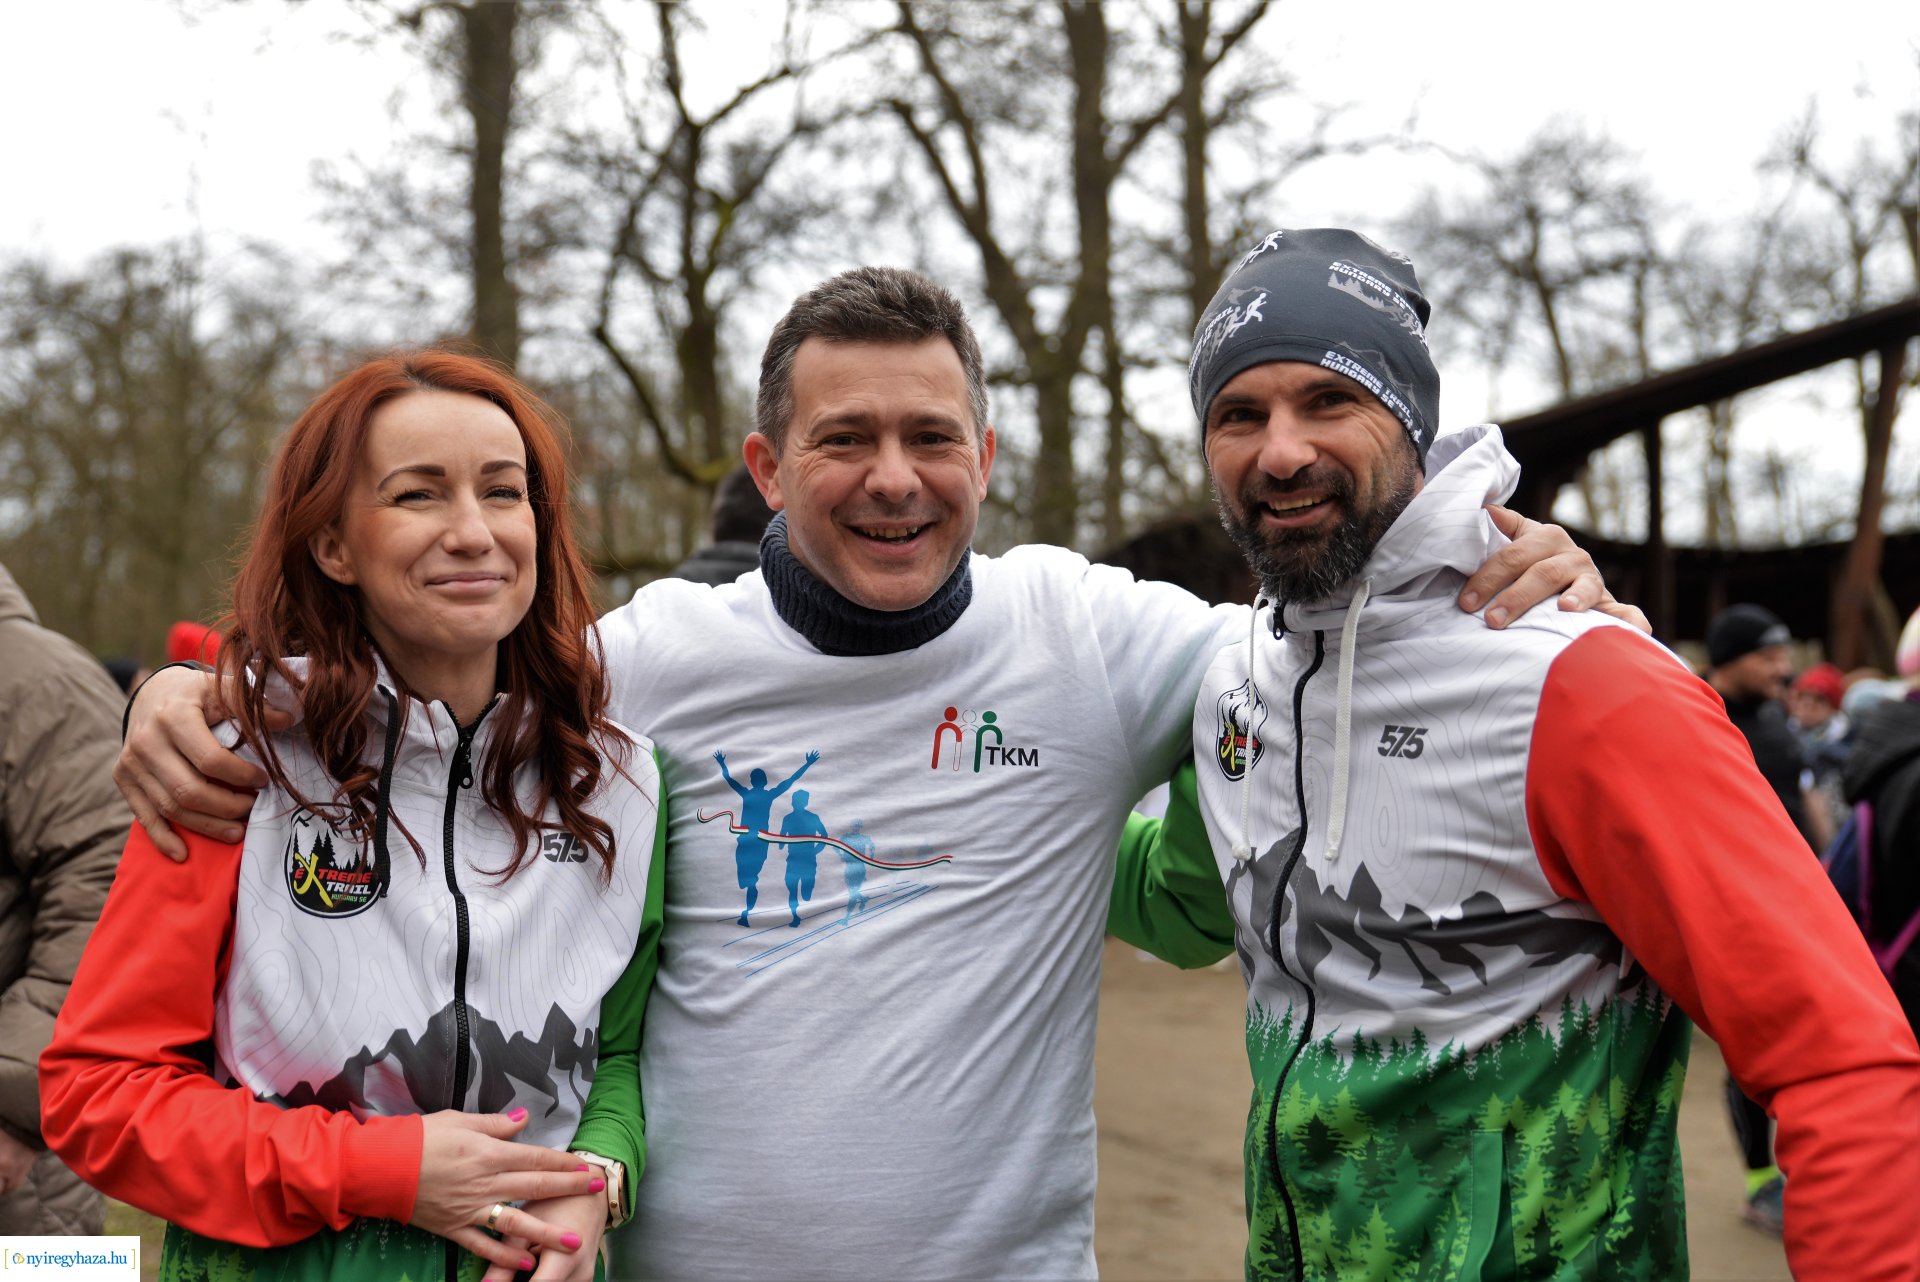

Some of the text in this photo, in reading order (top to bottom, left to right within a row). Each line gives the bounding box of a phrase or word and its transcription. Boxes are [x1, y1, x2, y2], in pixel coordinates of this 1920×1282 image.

[1320, 358, 1396, 409] HUNGARY SE
[1325, 350, 1411, 418] EXTREME TRAIL
[985, 746, 1039, 767] TKM
[1378, 725, 1429, 759] 575
